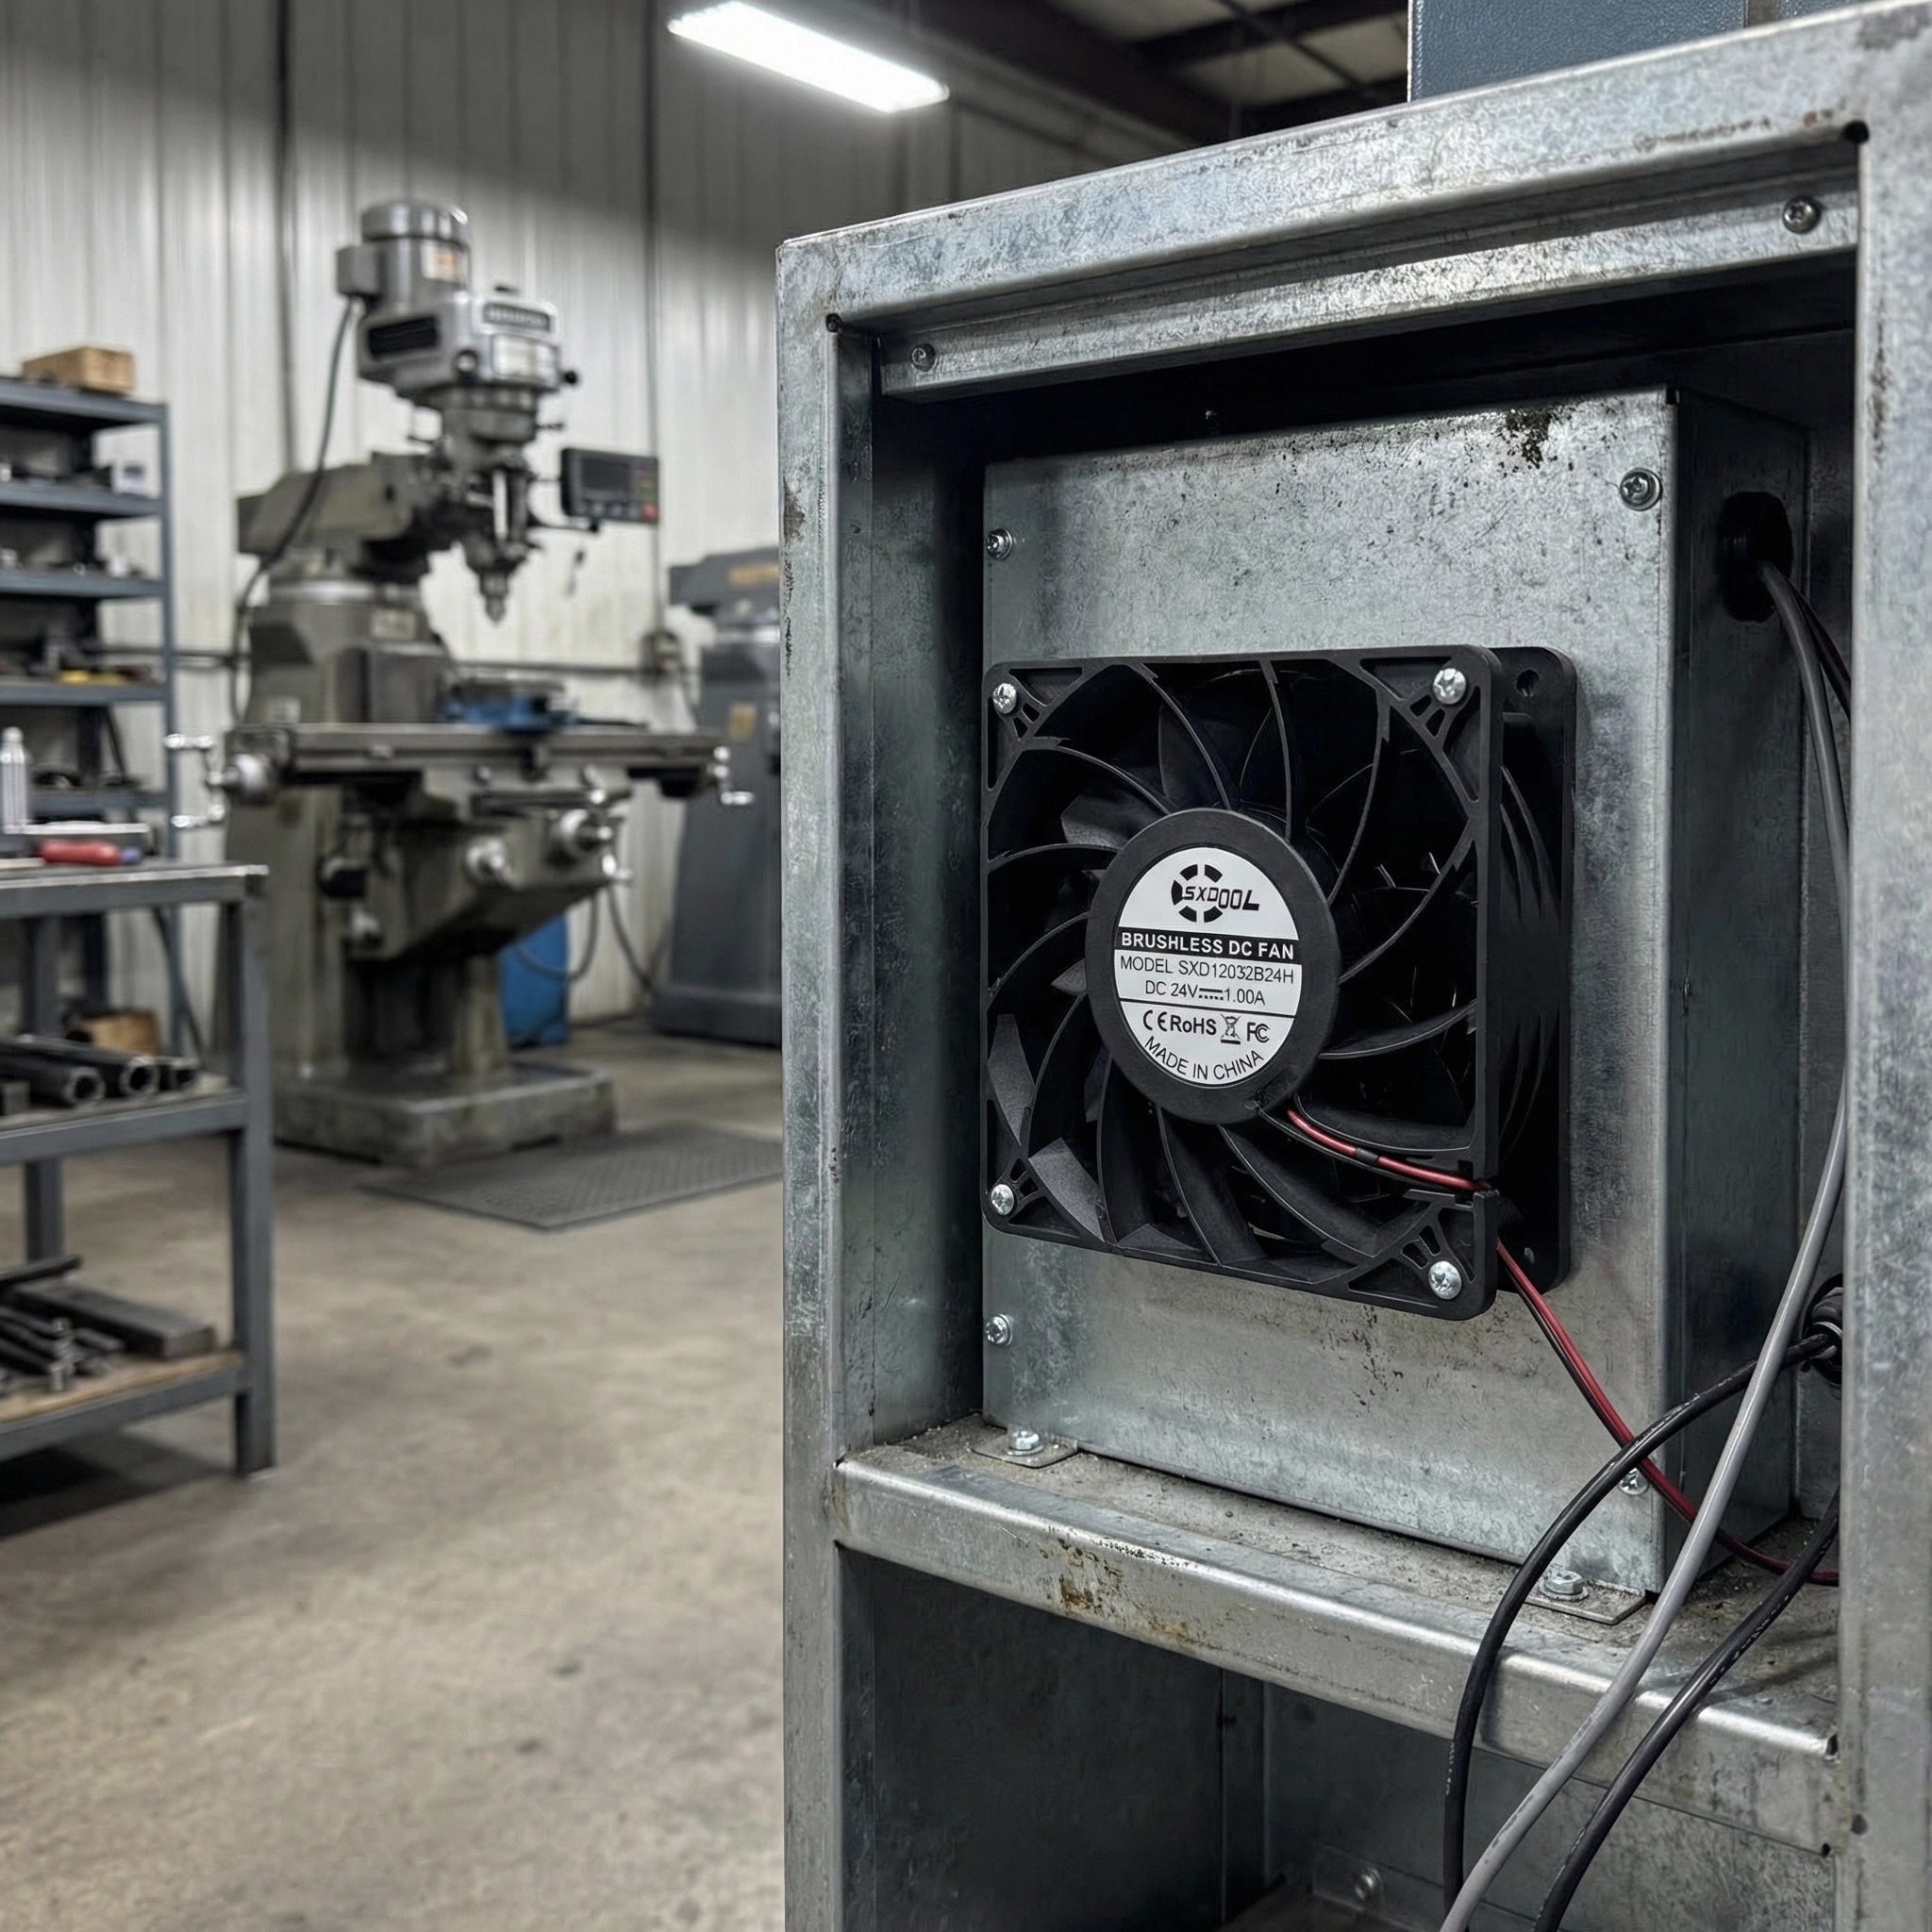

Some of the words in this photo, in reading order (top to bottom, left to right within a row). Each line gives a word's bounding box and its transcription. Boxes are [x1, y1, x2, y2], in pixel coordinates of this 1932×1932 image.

[1122, 931, 1224, 955] BRUSHLESS
[1228, 940, 1253, 957] DC
[1257, 942, 1294, 959] FAN
[1120, 956, 1174, 974] MODEL
[1178, 960, 1294, 983] SXD12032B24H
[1145, 980, 1167, 995] DC
[1171, 983, 1199, 998] 24V
[1224, 988, 1266, 1006] 1.00A
[1170, 1014, 1217, 1036] RoHS
[1144, 1036, 1189, 1075] MADE
[1192, 1063, 1208, 1080] IN
[1213, 1050, 1264, 1080] CHINA
